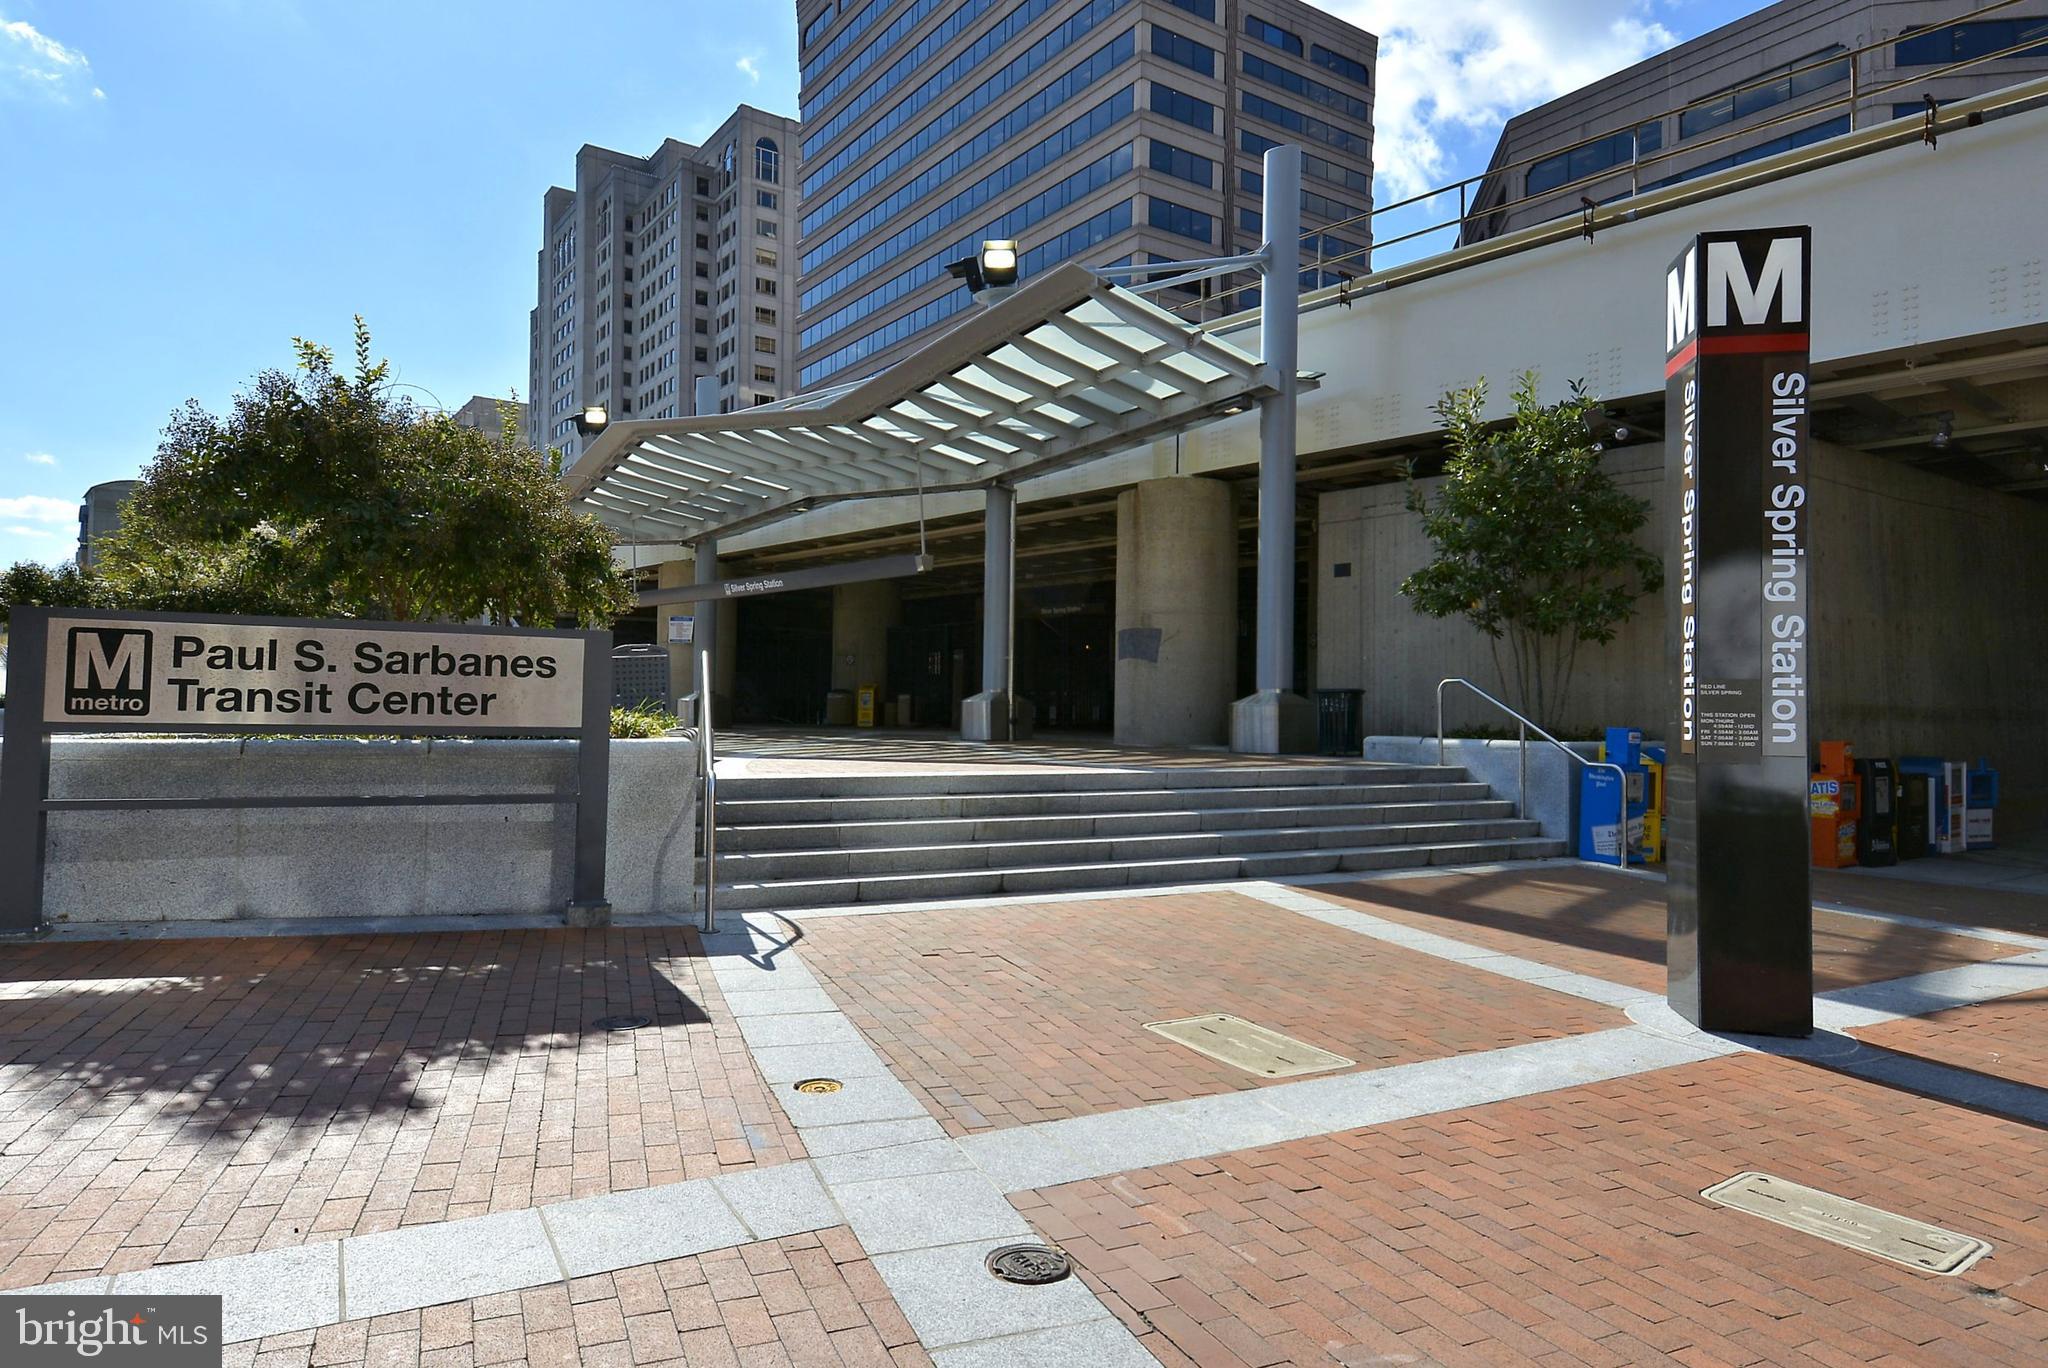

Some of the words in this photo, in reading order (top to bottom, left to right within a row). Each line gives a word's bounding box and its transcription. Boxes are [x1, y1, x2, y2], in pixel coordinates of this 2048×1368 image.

[1666, 246, 1696, 354] M
[1707, 237, 1802, 327] M
[1684, 380, 1696, 479] Silver
[1772, 372, 1806, 474] Silver
[745, 581, 764, 592] Spring
[763, 579, 784, 589] Station
[1681, 489, 1696, 604] Spring
[1764, 484, 1806, 602] Spring
[71, 695, 144, 711] metro
[73, 633, 146, 690] M
[167, 678, 333, 714] Transit
[347, 682, 497, 716] Center
[172, 636, 277, 671] Paul
[293, 640, 337, 673] S.
[353, 642, 557, 679] Sarbanes
[1683, 615, 1696, 741] Station
[1771, 614, 1805, 743] Station
[1810, 782, 1838, 794] ATIS
